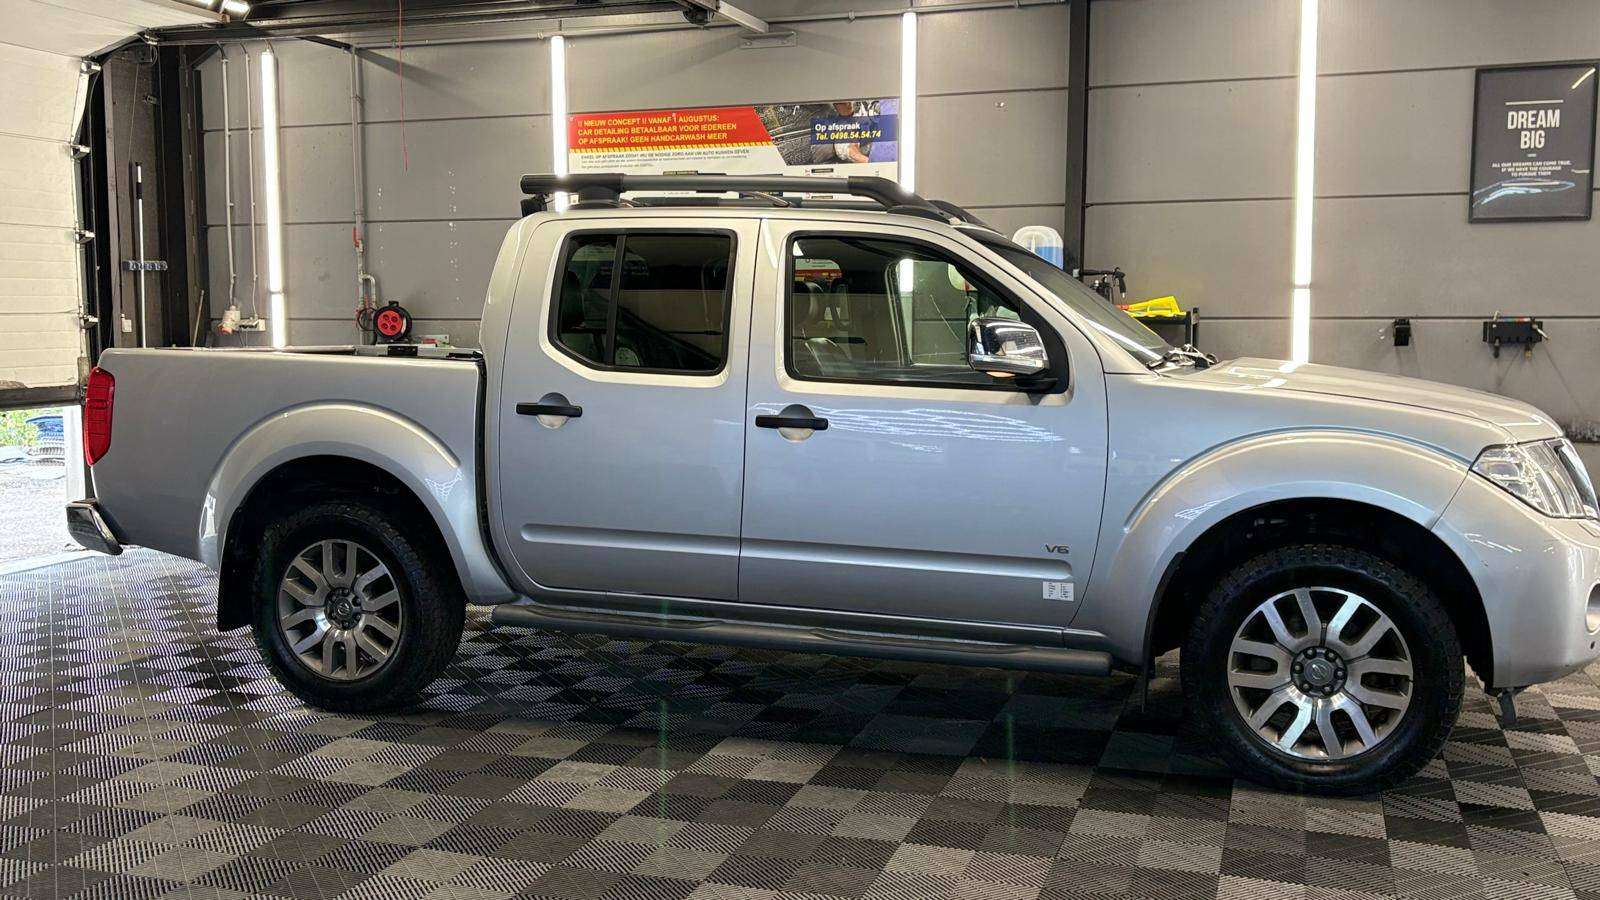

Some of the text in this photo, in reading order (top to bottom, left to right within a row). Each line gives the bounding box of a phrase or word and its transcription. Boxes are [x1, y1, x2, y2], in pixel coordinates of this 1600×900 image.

[1507, 109, 1560, 129] DREAM
[631, 125, 677, 134] BETAALBAAR
[828, 122, 860, 131] afspraak
[1520, 130, 1546, 149] BIG
[1045, 544, 1070, 554] V6
